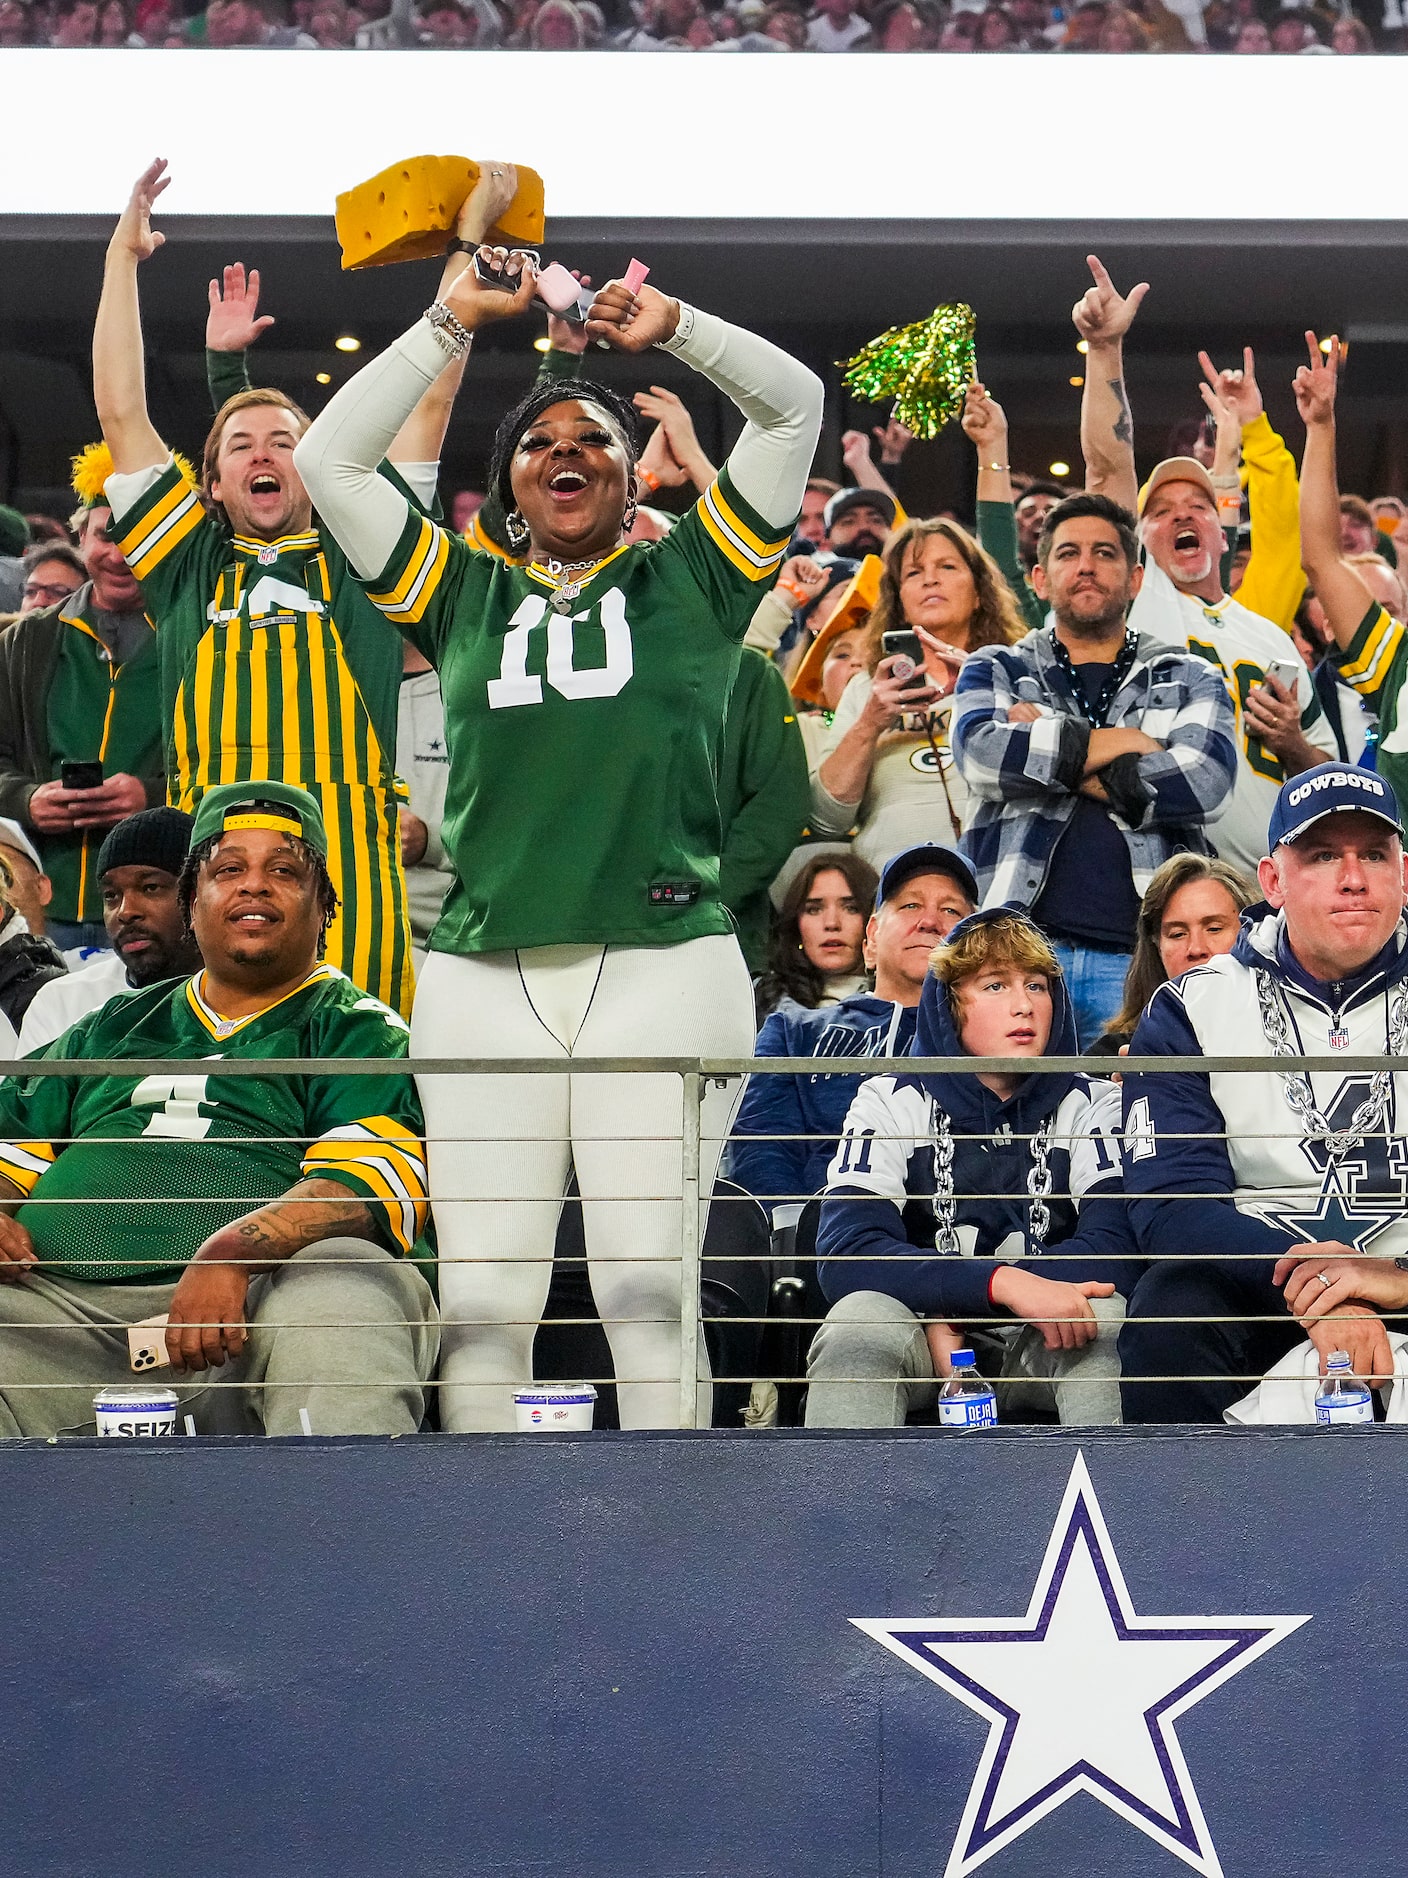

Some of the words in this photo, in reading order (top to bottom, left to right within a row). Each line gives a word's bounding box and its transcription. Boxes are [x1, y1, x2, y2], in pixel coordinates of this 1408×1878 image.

[487, 587, 634, 710] 10
[1288, 772, 1385, 807] COWBOYS
[1331, 1035, 1348, 1047] NFL
[1123, 1096, 1157, 1163] 4
[838, 1127, 876, 1174] 11
[967, 1403, 991, 1422] DEJA
